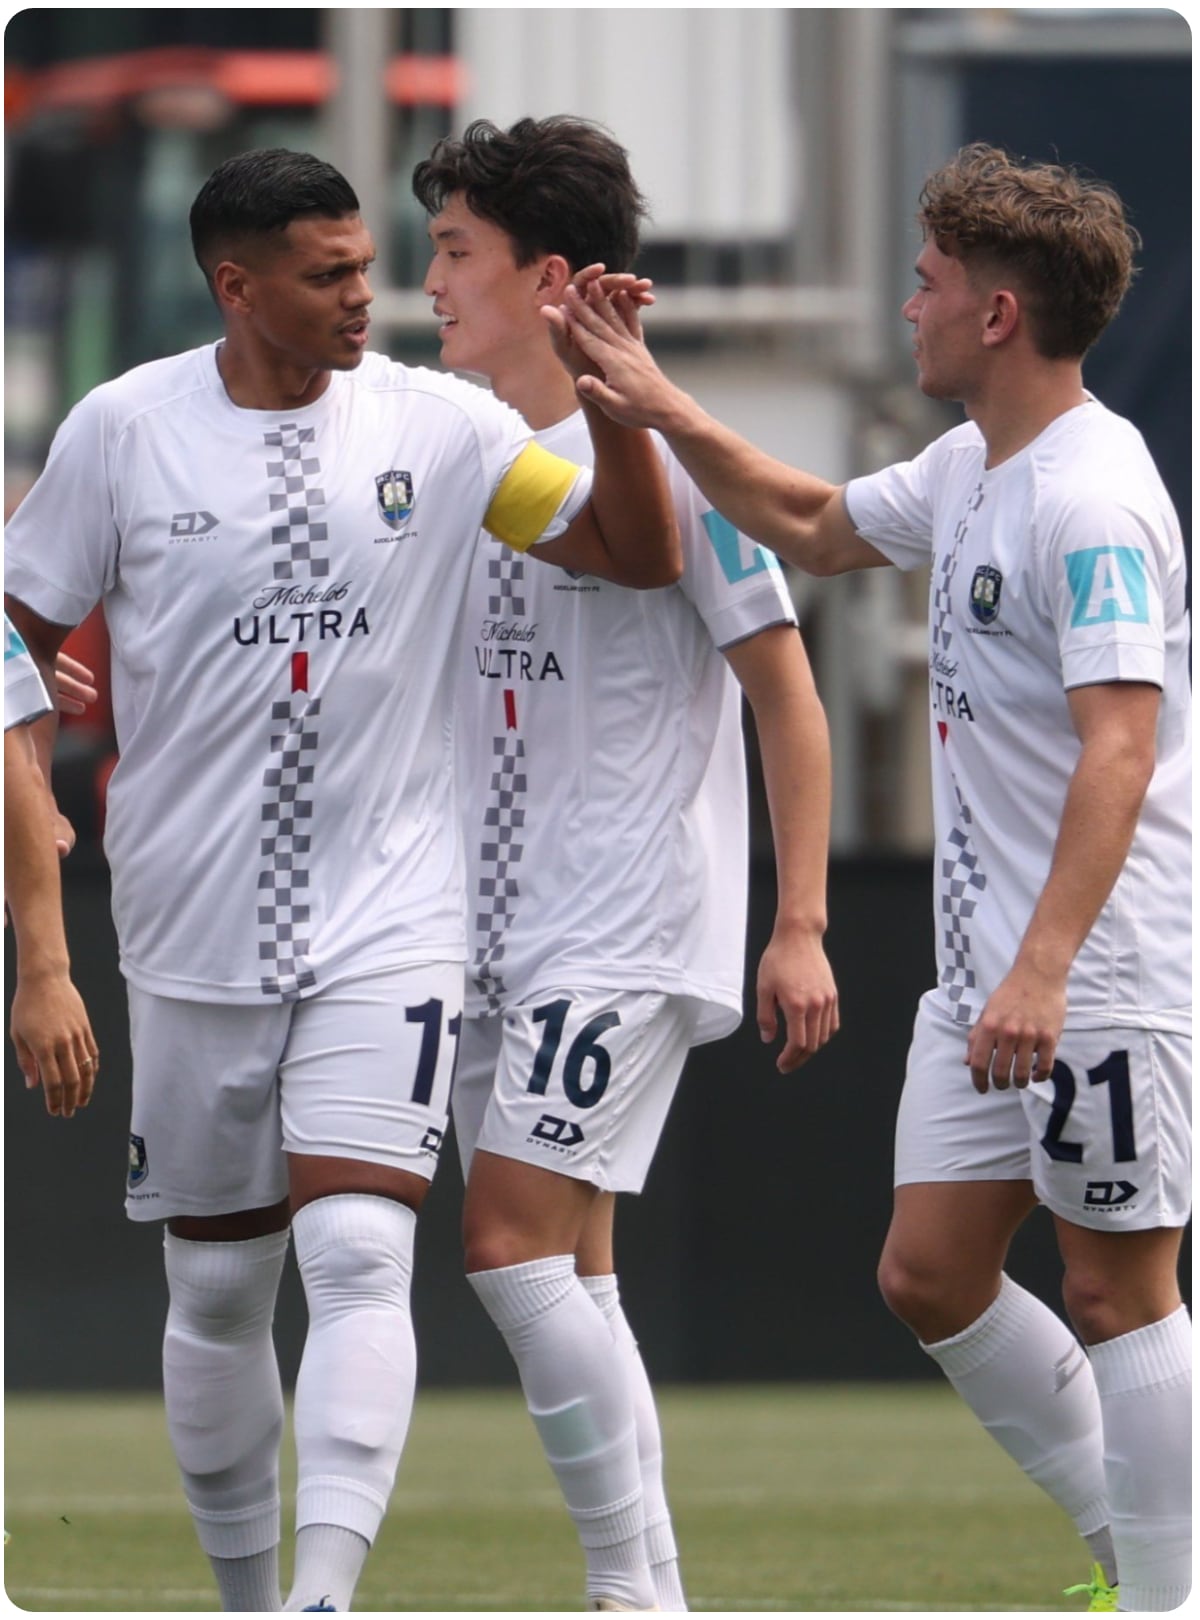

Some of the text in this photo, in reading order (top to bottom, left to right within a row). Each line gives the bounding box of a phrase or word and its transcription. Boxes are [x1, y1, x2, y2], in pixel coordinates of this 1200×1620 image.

[253, 581, 352, 610] Michelob
[1085, 553, 1136, 618] A
[234, 607, 370, 646] ULTRA
[475, 646, 564, 681] ULTRA
[931, 677, 975, 722] TRA
[527, 998, 622, 1109] 16
[1032, 1050, 1137, 1164] 21
[1083, 1204, 1137, 1212] DYNASTY
